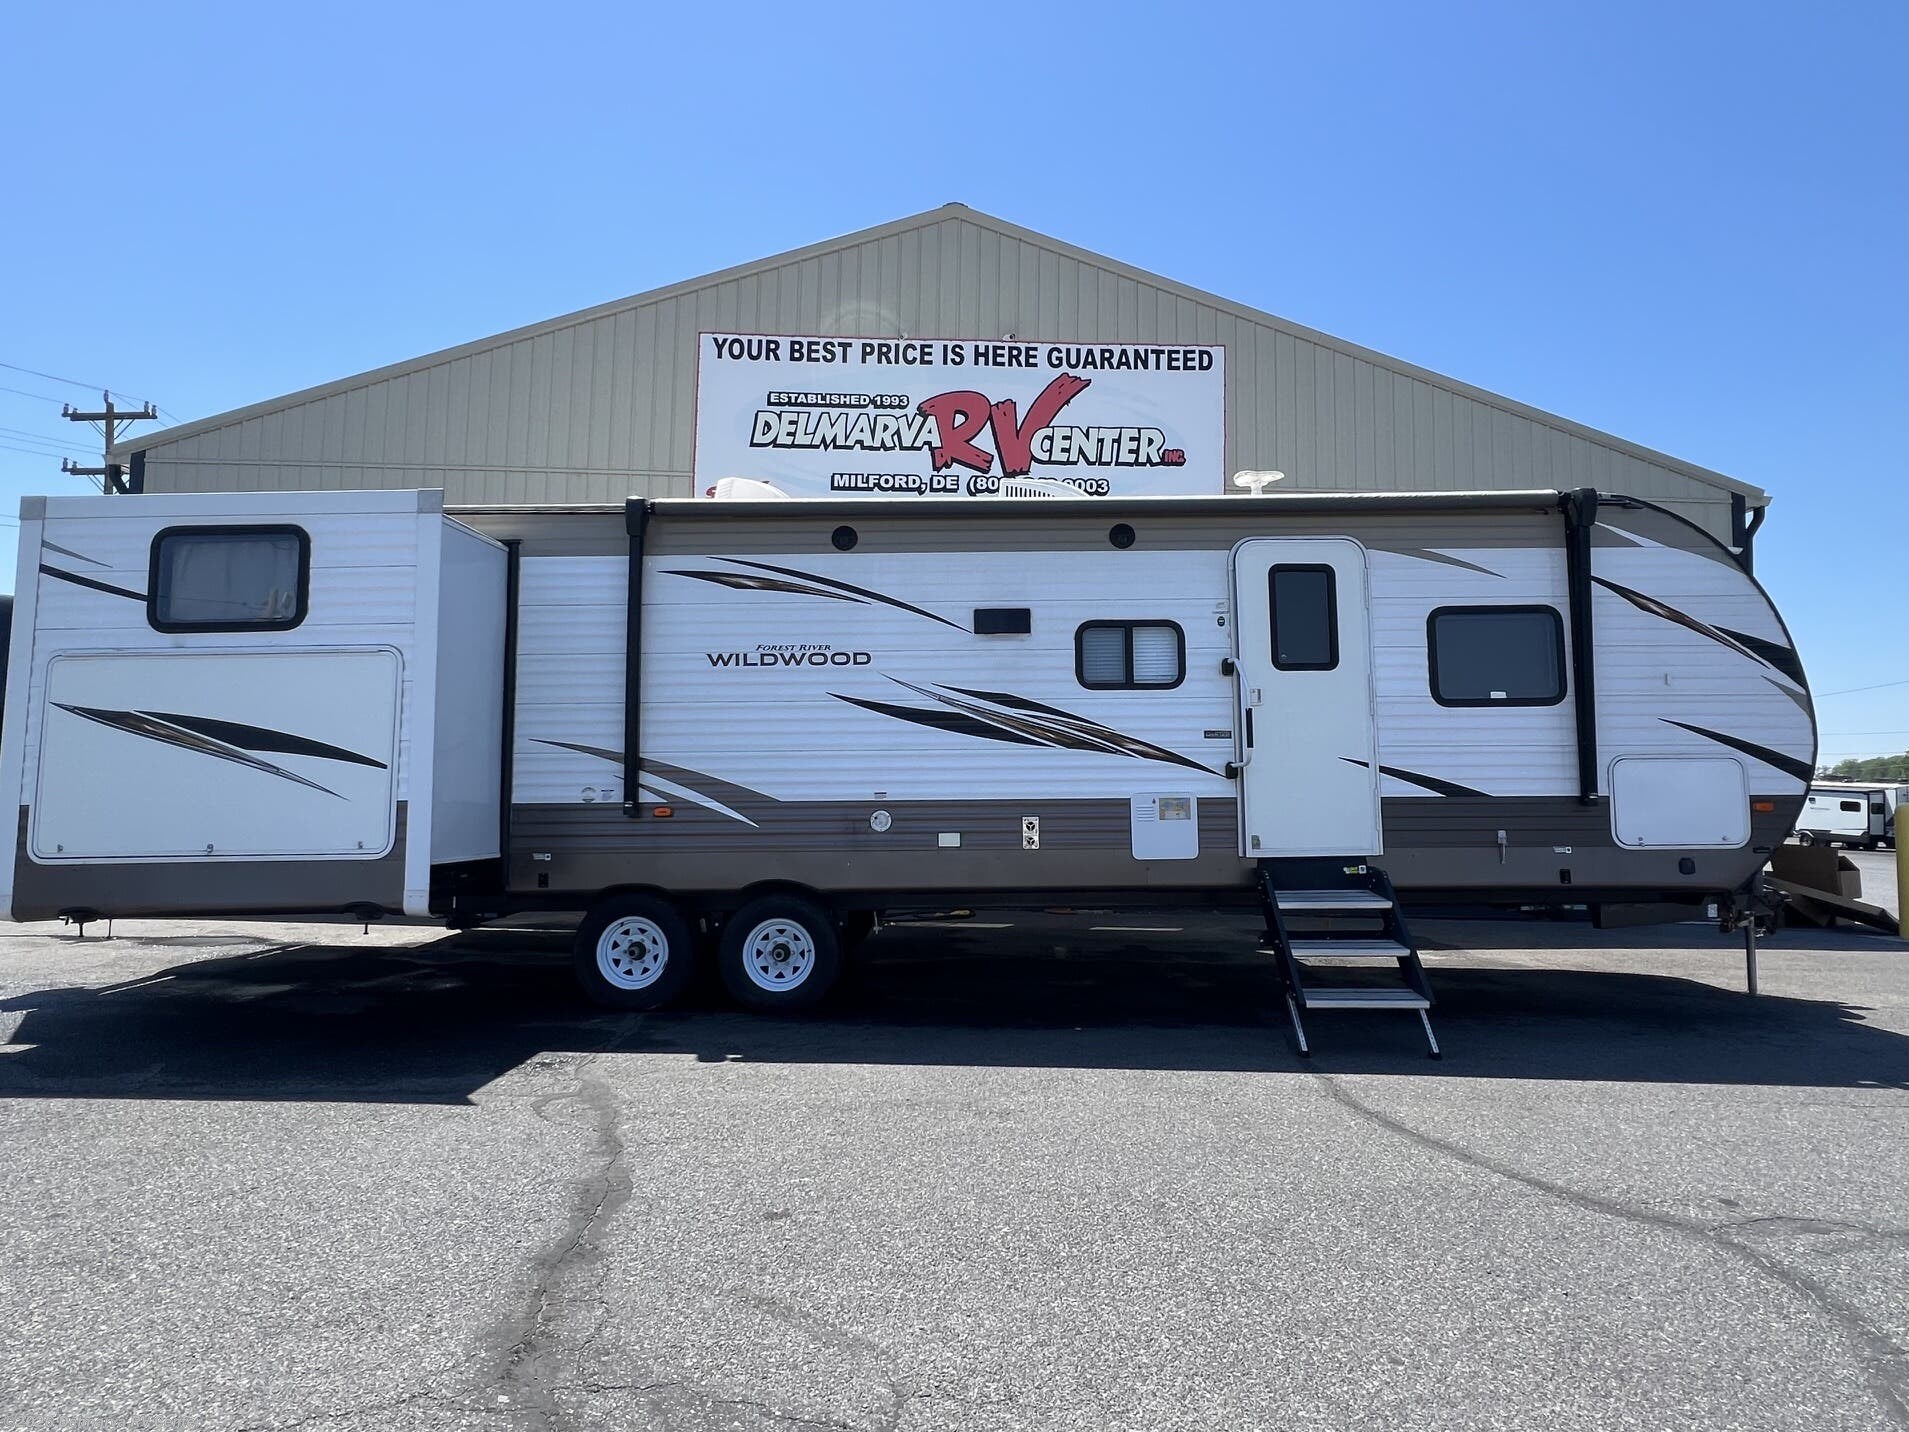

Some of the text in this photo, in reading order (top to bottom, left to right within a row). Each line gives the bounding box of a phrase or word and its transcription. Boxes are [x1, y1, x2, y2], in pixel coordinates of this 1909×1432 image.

[713, 337, 1214, 371] YOUR BEST PRICE IS HERE GUARANTEED
[769, 392, 909, 407] ESTABLISHED 1993
[751, 411, 943, 450] DELMARVA
[917, 373, 1092, 477] RV
[1031, 426, 1165, 466] CENTER
[832, 474, 928, 492] MILFORD,
[932, 475, 959, 490] DE
[707, 652, 872, 667] WILDWOOD
